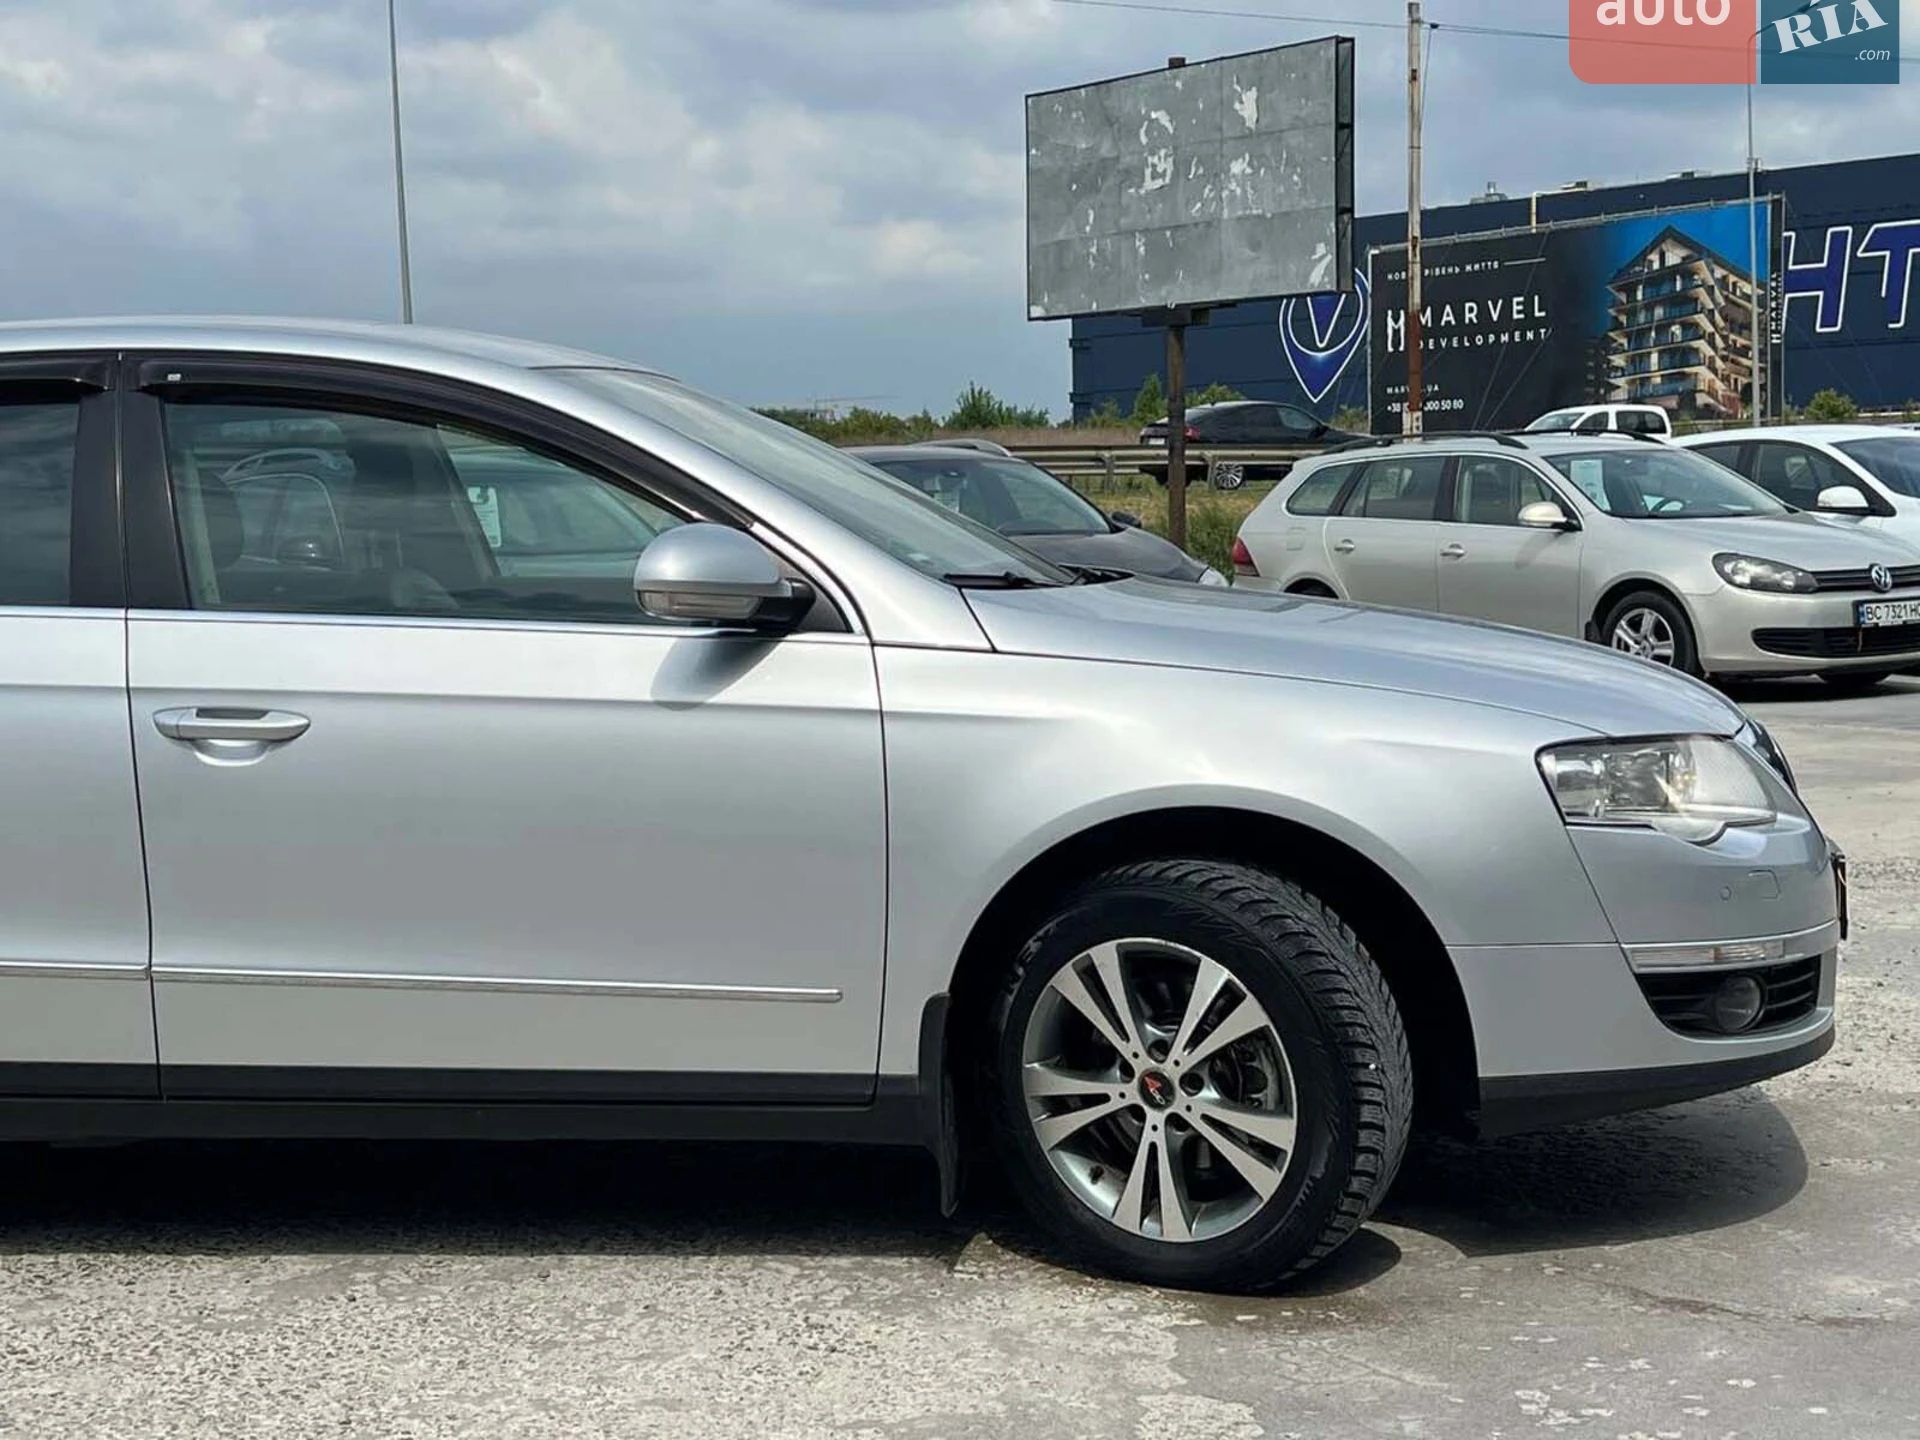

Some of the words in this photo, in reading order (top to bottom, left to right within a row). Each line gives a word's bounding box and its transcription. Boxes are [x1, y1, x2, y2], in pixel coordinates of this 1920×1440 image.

[1420, 294, 1547, 328] MARVEL
[1866, 605, 1882, 621] BC
[1884, 603, 1908, 620] 7321
